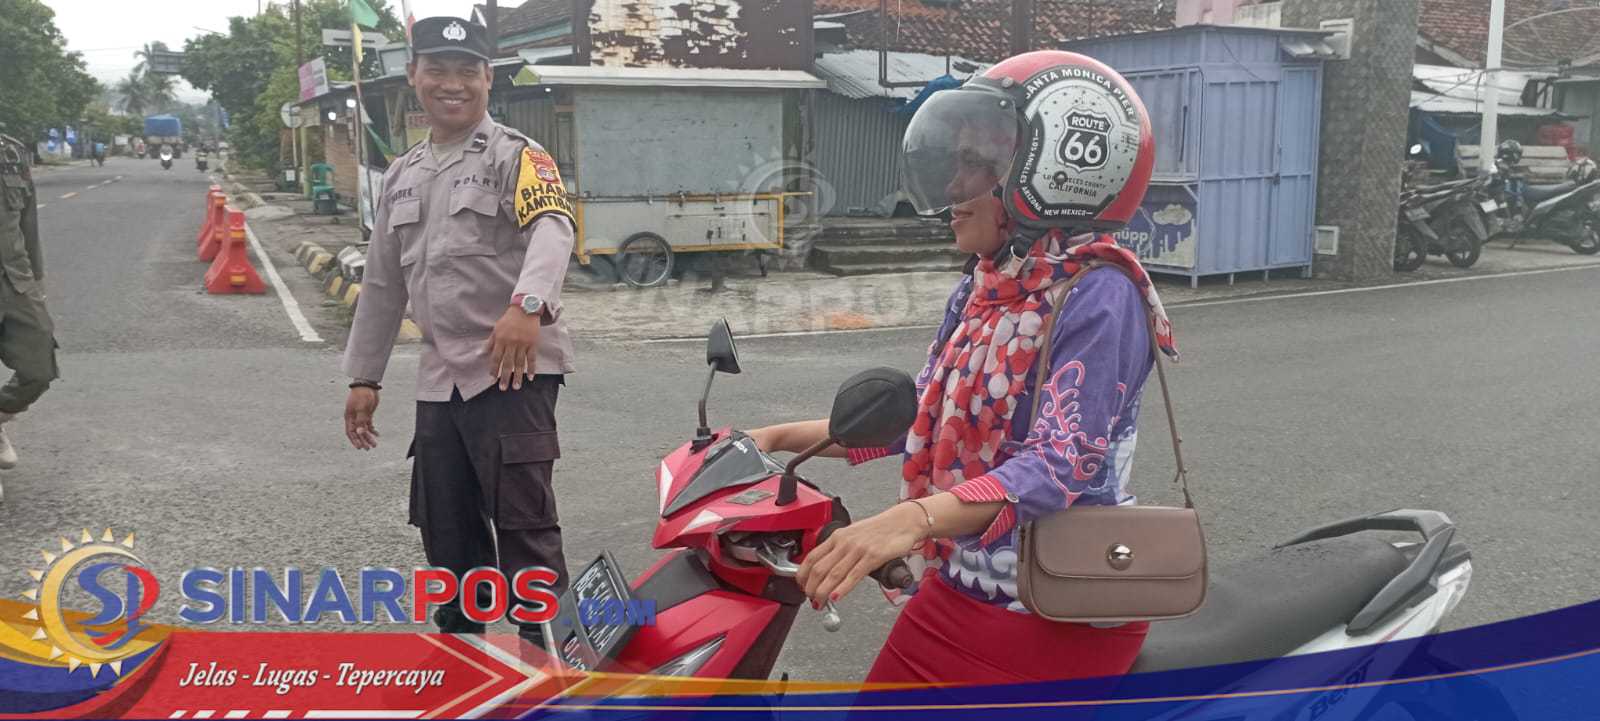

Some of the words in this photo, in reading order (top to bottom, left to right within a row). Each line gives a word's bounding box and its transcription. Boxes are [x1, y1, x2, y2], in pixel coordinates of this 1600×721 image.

[1061, 68, 1111, 89] MONICA
[1112, 87, 1135, 116] PIER
[1071, 115, 1106, 131] ROUTE
[1064, 131, 1102, 164] 66
[454, 174, 499, 189] POLRI
[1048, 181, 1097, 197] CALIFORNIA
[1044, 208, 1060, 216] NEW
[1061, 208, 1087, 217] MEXICO
